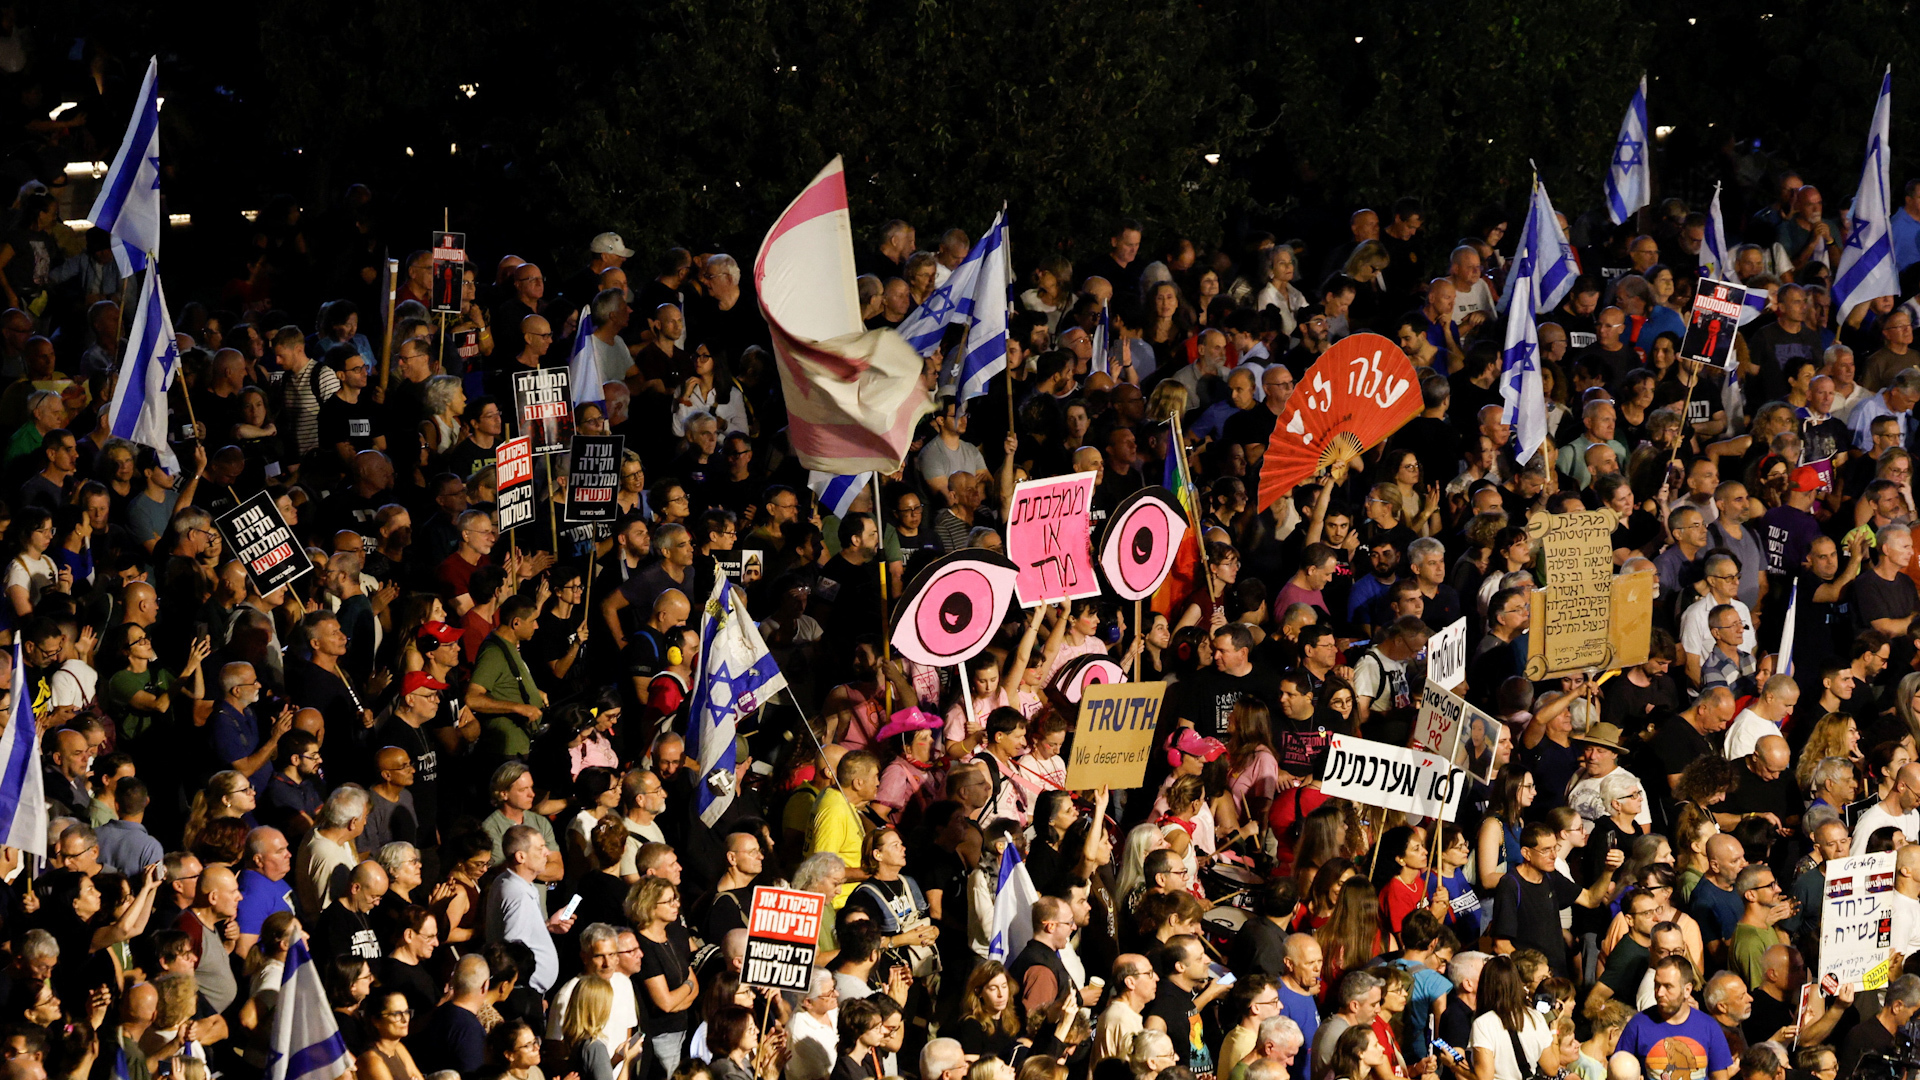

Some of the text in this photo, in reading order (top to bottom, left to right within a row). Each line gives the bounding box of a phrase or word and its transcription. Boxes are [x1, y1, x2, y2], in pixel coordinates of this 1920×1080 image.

[1695, 295, 1741, 317] השתמטות
[518, 372, 567, 392] ממשלת
[1348, 350, 1410, 408] עלה
[525, 387, 563, 405] הטבח
[525, 401, 567, 420] הביתה
[507, 441, 528, 461] הפקרת
[585, 443, 613, 457] ועדת
[498, 456, 530, 487] הביטחון
[578, 457, 614, 472] חקירה
[570, 471, 617, 486] ממלכתית
[498, 484, 532, 508] כדי להישאר
[574, 487, 612, 502] עכשיו!
[1011, 484, 1085, 526] ממלכתית
[232, 504, 265, 532] ועדת
[500, 499, 532, 530] בשלטון
[1552, 514, 1605, 531] מגילת
[235, 515, 276, 547] חקירה
[1043, 519, 1061, 555] או
[1548, 527, 1610, 542] הדיקטטורה
[238, 526, 290, 565] ממלכתית
[1547, 545, 1611, 558] רשע ופשע
[251, 542, 293, 575] עכשיו!
[1584, 556, 1613, 568] שנאה
[1031, 553, 1077, 592] מרד
[1551, 568, 1611, 583] גזל וביזה
[1553, 581, 1611, 599] אש ואסון
[1551, 607, 1606, 623] סרבנות
[1546, 619, 1610, 635] וניצול החיילים
[1075, 746, 1091, 765] We
[1093, 745, 1135, 764] deserve
[1426, 768, 1464, 804] לא
[759, 891, 819, 915] הפקרת את
[1831, 896, 1881, 917] ביחד
[753, 908, 818, 938] הביטחון
[1880, 909, 1891, 919] 7.10
[1835, 920, 1878, 944] נטייח
[749, 940, 813, 965] כדי להישאר
[746, 958, 808, 988] בשלטון
